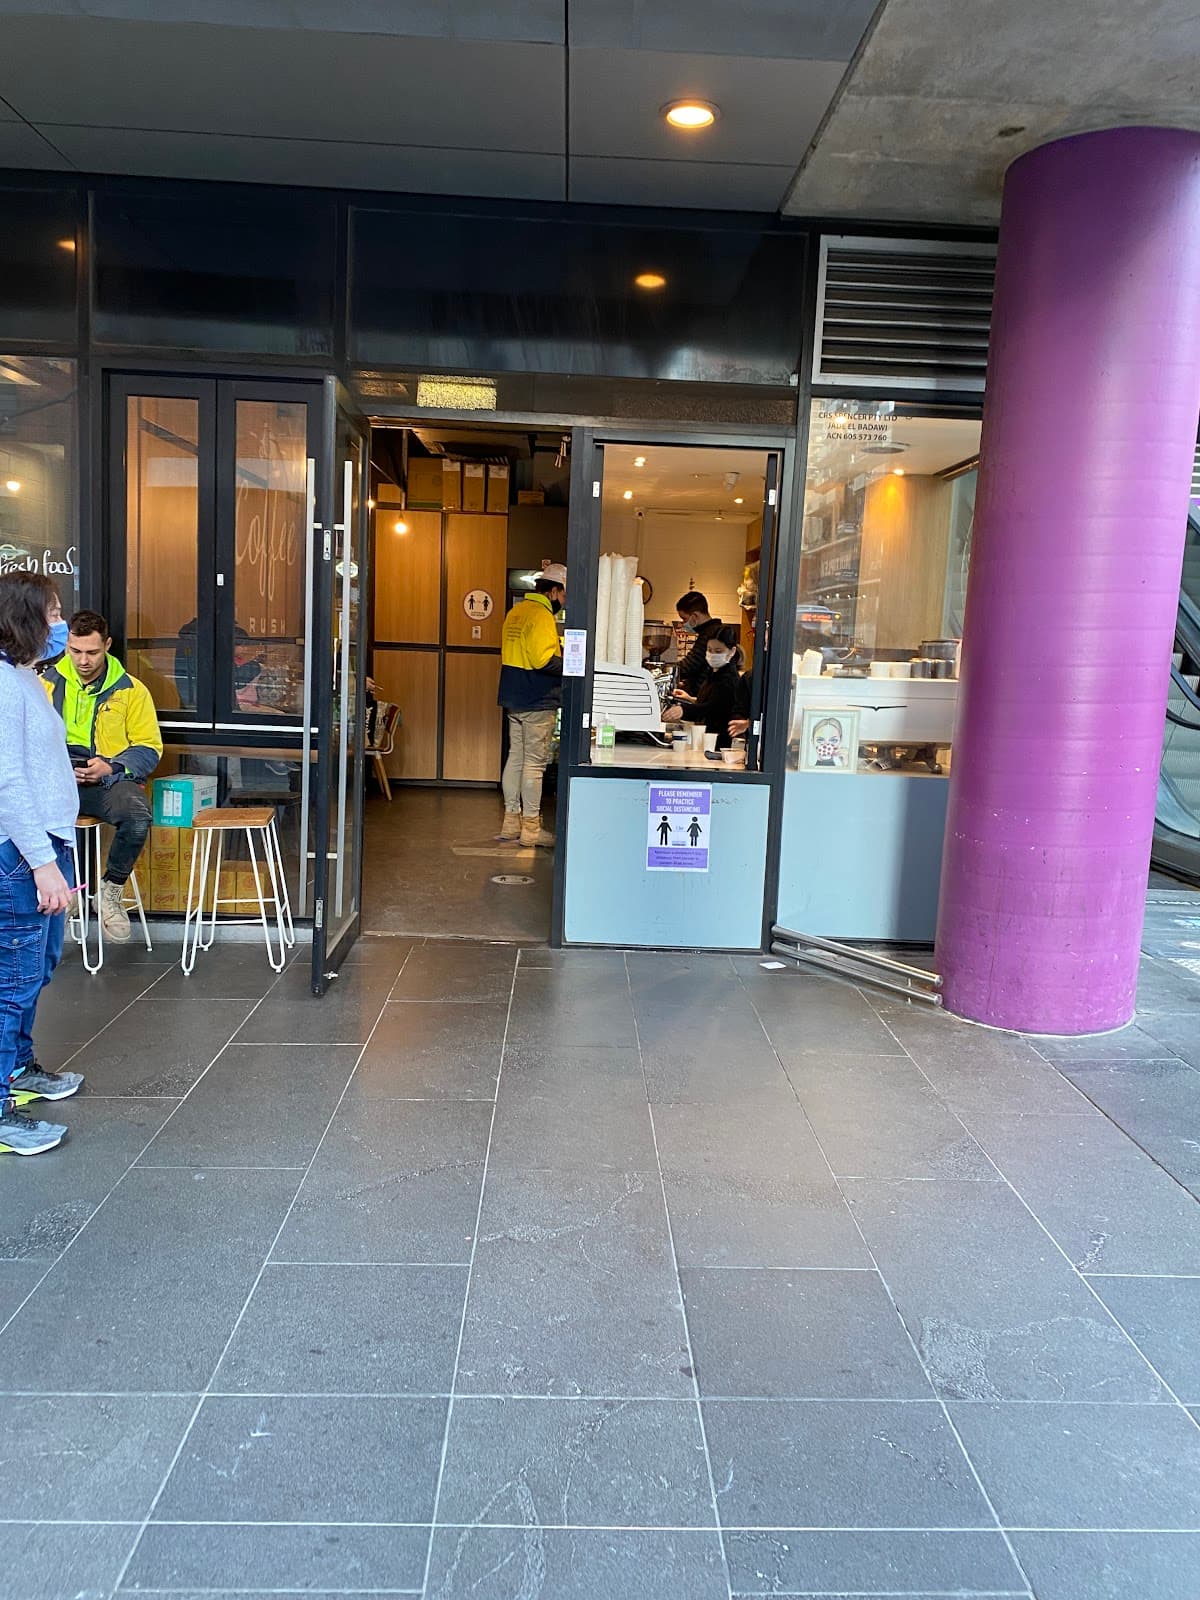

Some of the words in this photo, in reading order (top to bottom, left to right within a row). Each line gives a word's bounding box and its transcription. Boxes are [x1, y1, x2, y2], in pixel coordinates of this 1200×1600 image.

[884, 414, 898, 422] LTD
[847, 422, 856, 430] EL
[843, 432, 857, 440] 605
[43, 546, 76, 577] food
[249, 617, 286, 634] RUSH
